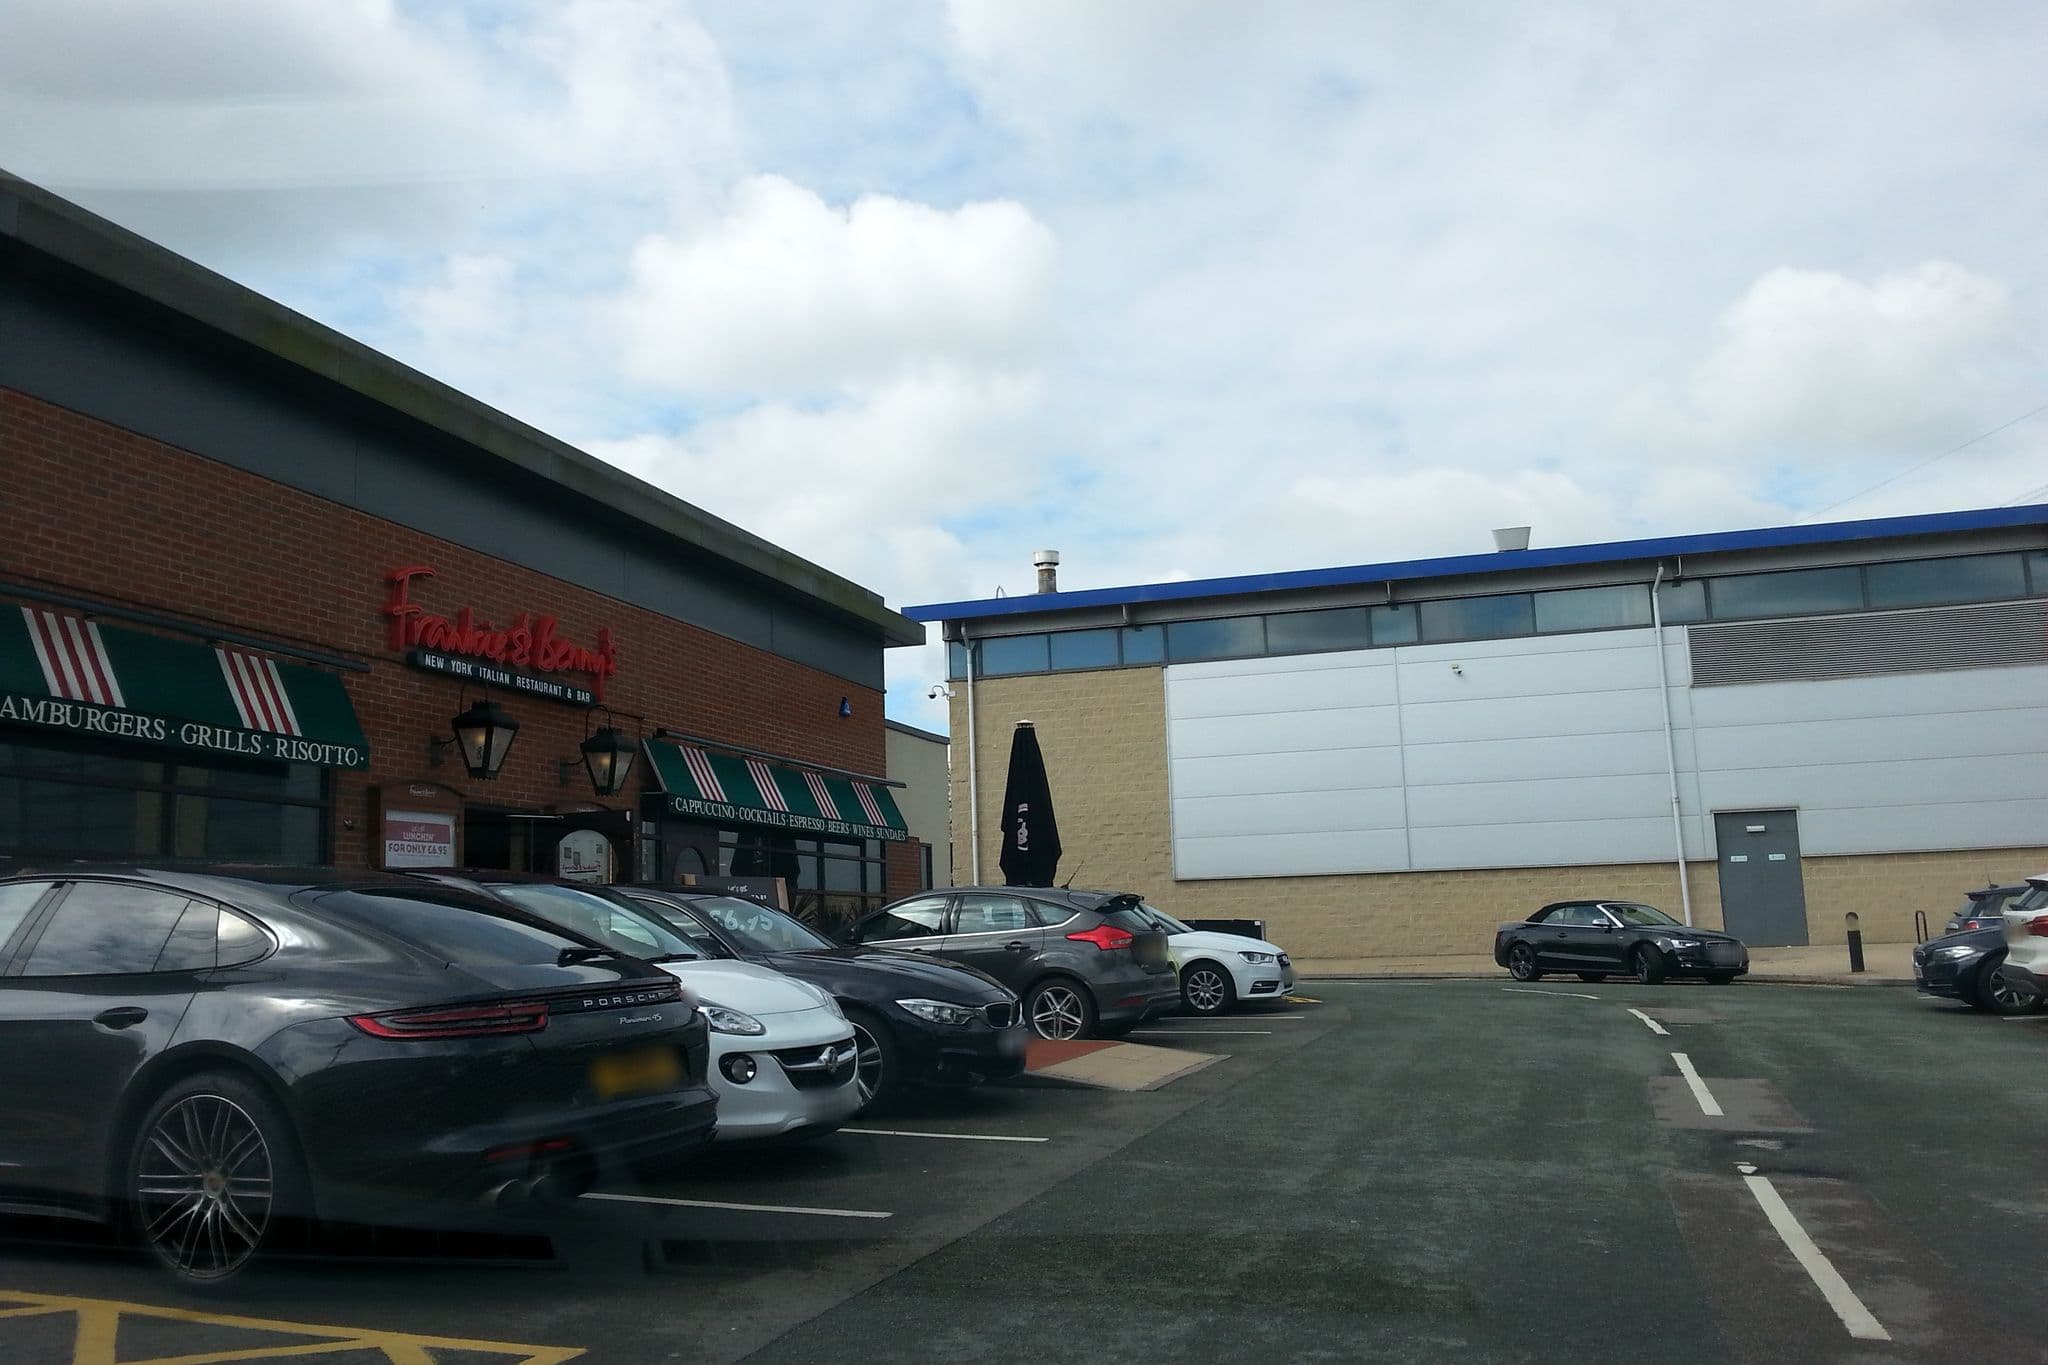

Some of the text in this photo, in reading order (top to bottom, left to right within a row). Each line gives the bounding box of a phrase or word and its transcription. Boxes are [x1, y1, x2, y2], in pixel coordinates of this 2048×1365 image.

[425, 654, 591, 704] NEW YORK ITALIAN RESTAURANT & BAR
[0, 695, 359, 767] AMBURGERS GRILLS RISOTTO
[675, 797, 906, 841] CAPPUCCINO COCKTAILS ESPRESSO BEERS WINES SUNDAES
[388, 843, 406, 853] FOR
[406, 844, 427, 854] ONLY
